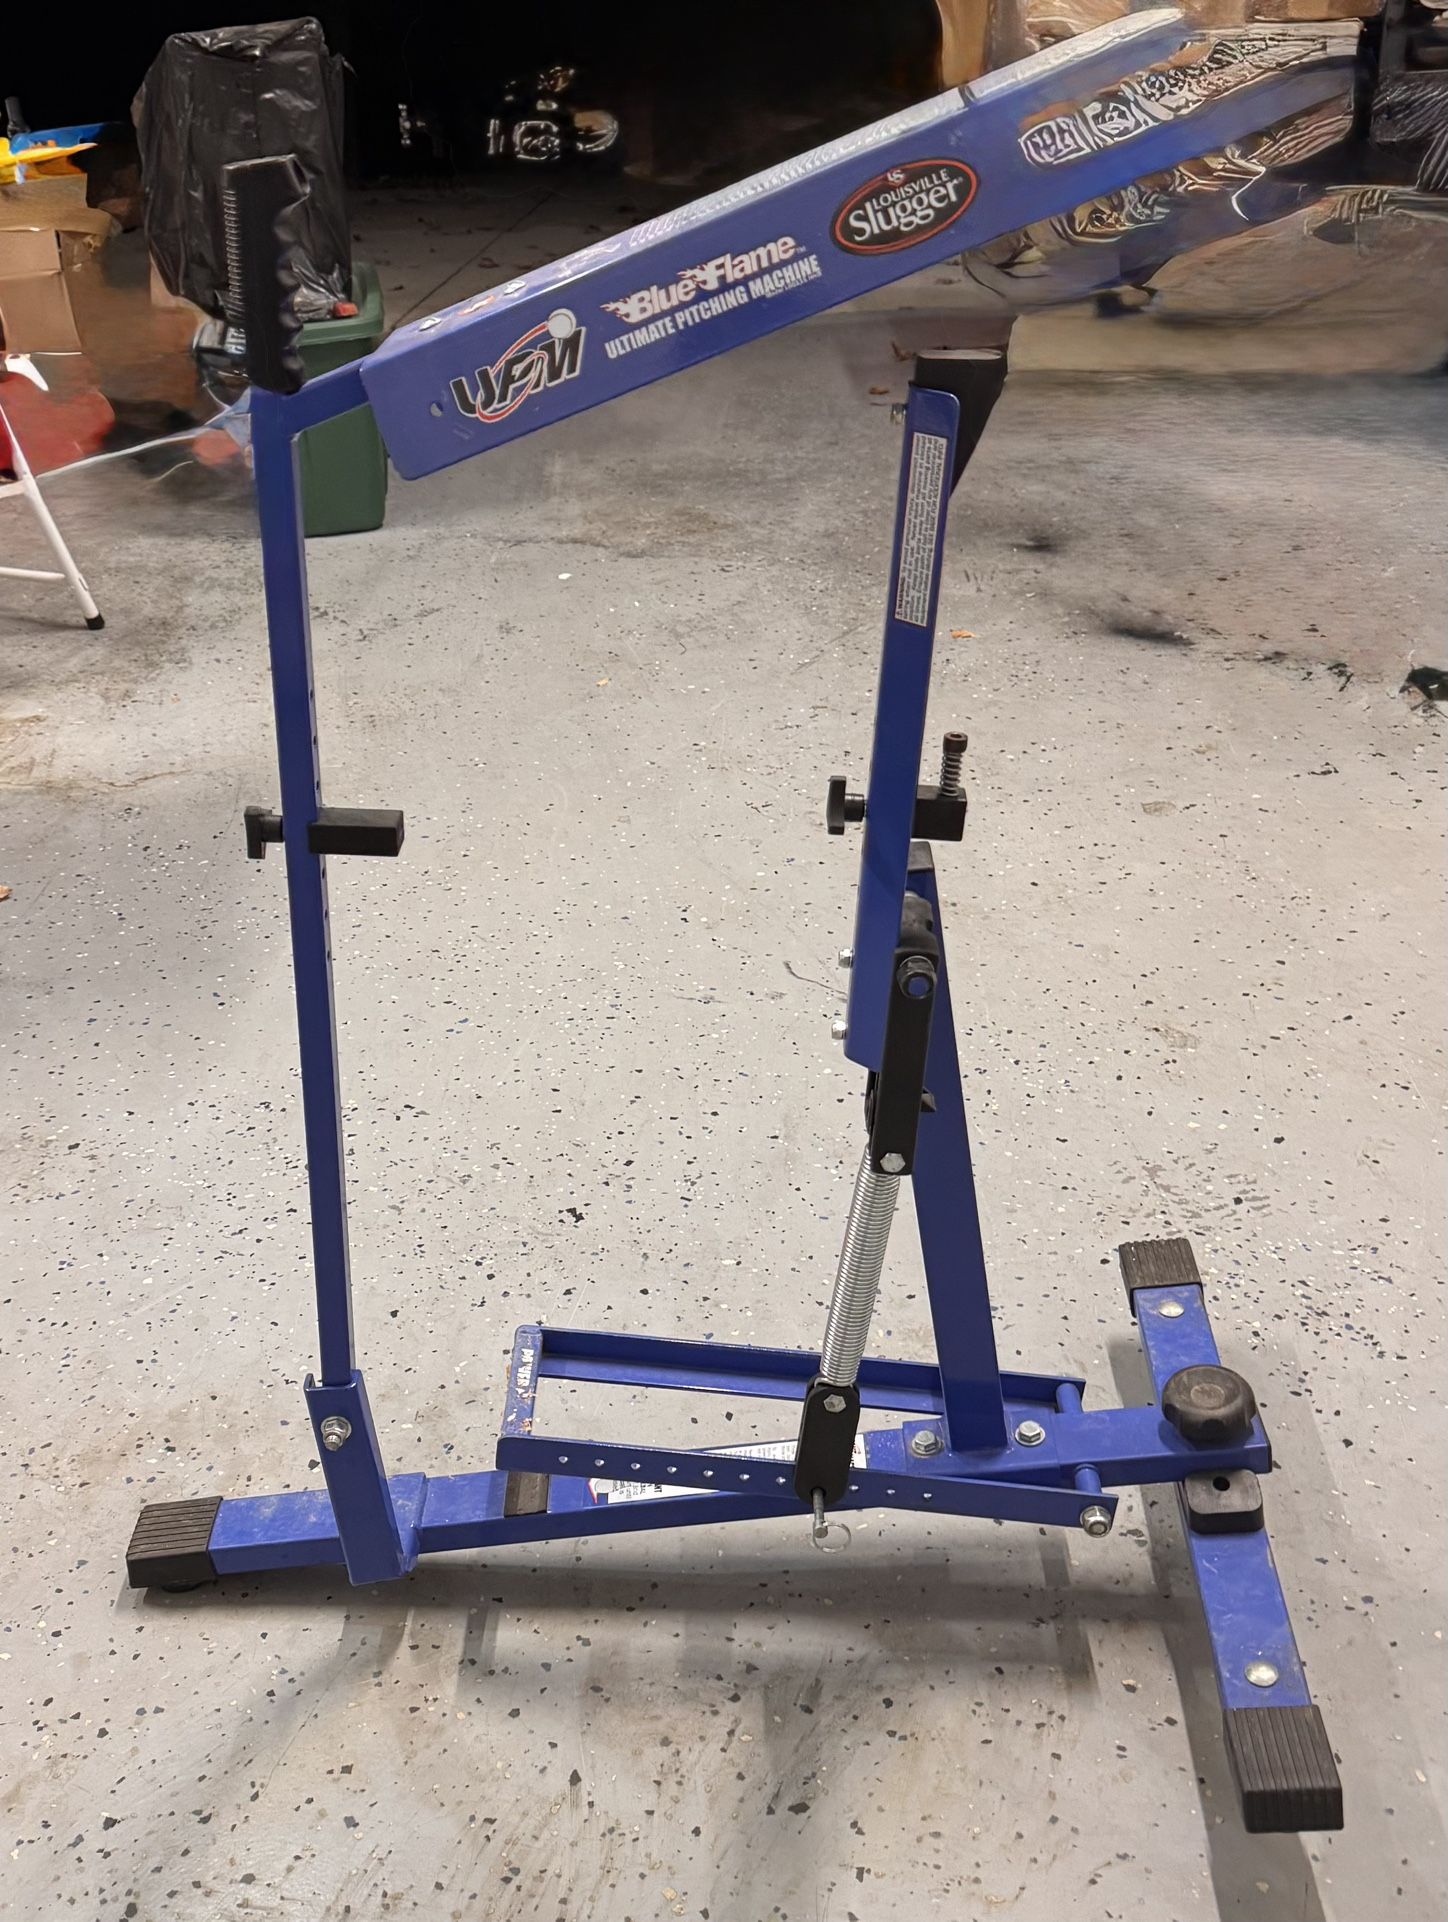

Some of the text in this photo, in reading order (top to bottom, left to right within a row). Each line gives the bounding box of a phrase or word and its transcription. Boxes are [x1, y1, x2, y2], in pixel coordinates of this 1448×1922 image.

[848, 178, 961, 241] Slugger
[872, 168, 950, 210] LOUISVILLE
[604, 316, 676, 360] ULTIMATE
[674, 285, 749, 331] PITCHING
[747, 254, 822, 299] MACHINE
[450, 325, 587, 419] UPM
